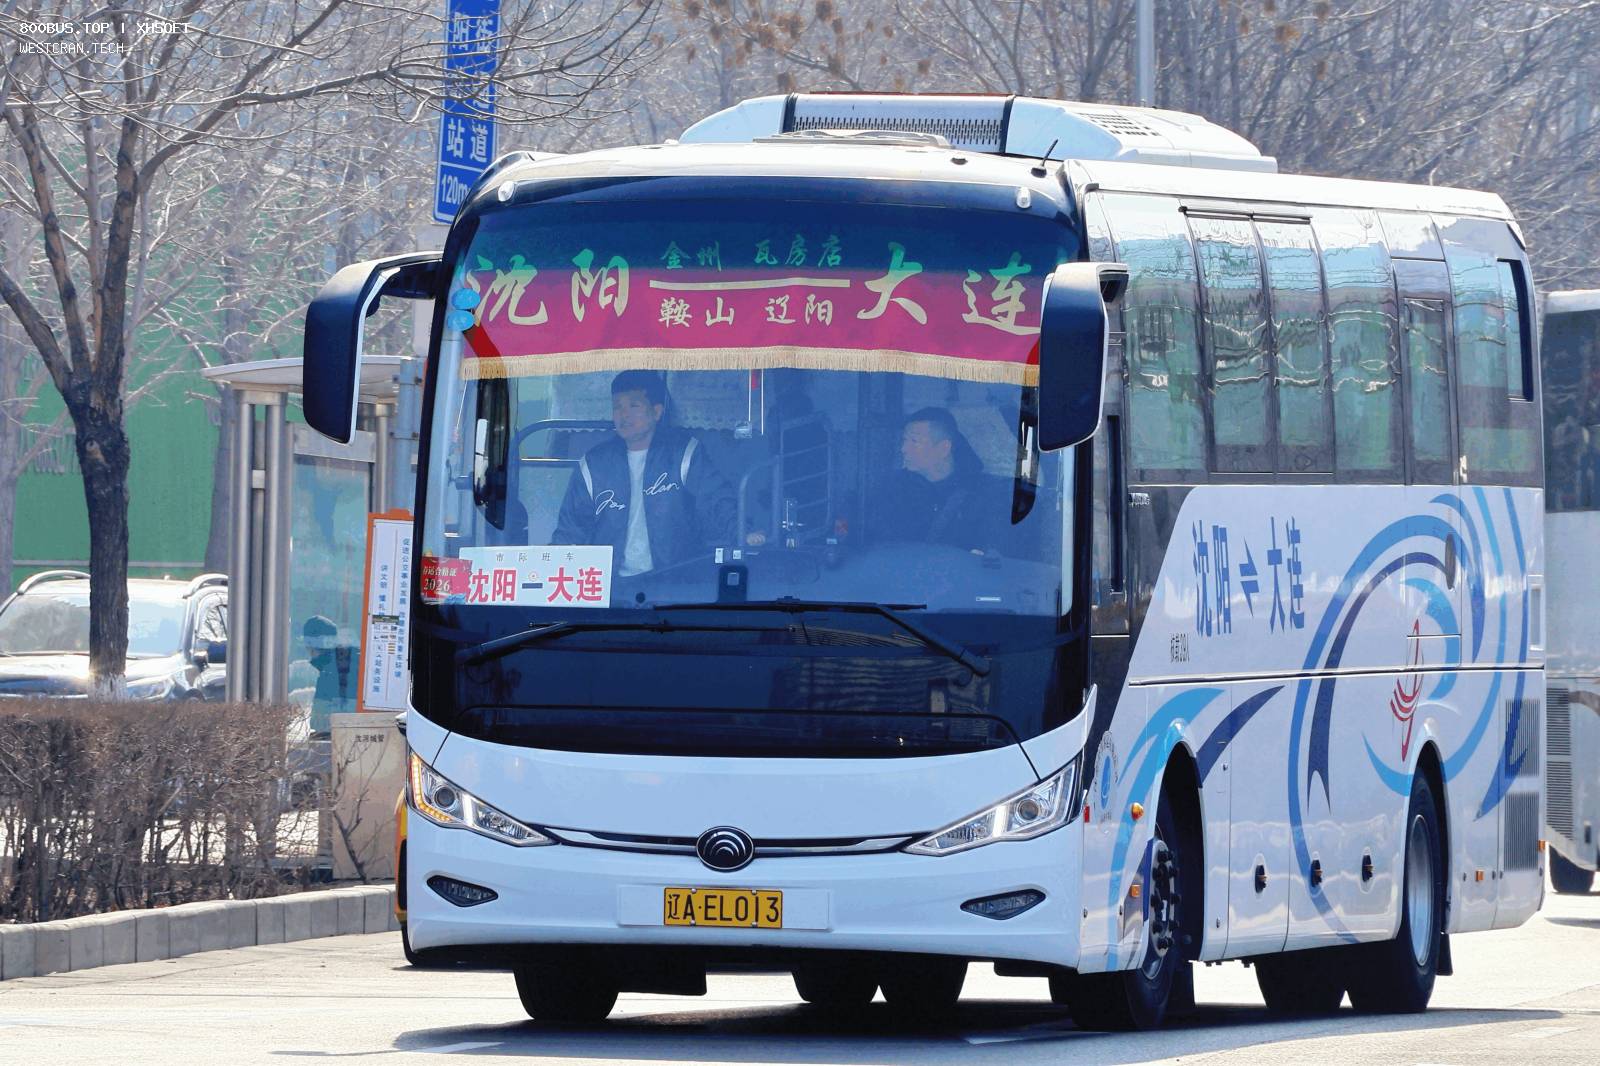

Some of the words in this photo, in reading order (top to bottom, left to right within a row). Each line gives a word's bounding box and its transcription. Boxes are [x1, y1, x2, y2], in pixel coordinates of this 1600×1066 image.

[660, 240, 722, 272] 金州
[754, 234, 842, 268] 瓦房店
[466, 249, 630, 326] 沈阳
[856, 241, 1041, 336] 大连
[658, 296, 735, 328] 鞍山
[765, 293, 833, 326] 辽阳
[496, 552, 577, 562] 市际班车
[423, 578, 450, 592] 2026
[1192, 519, 1232, 637] 沈阳
[1266, 516, 1305, 634] 大连
